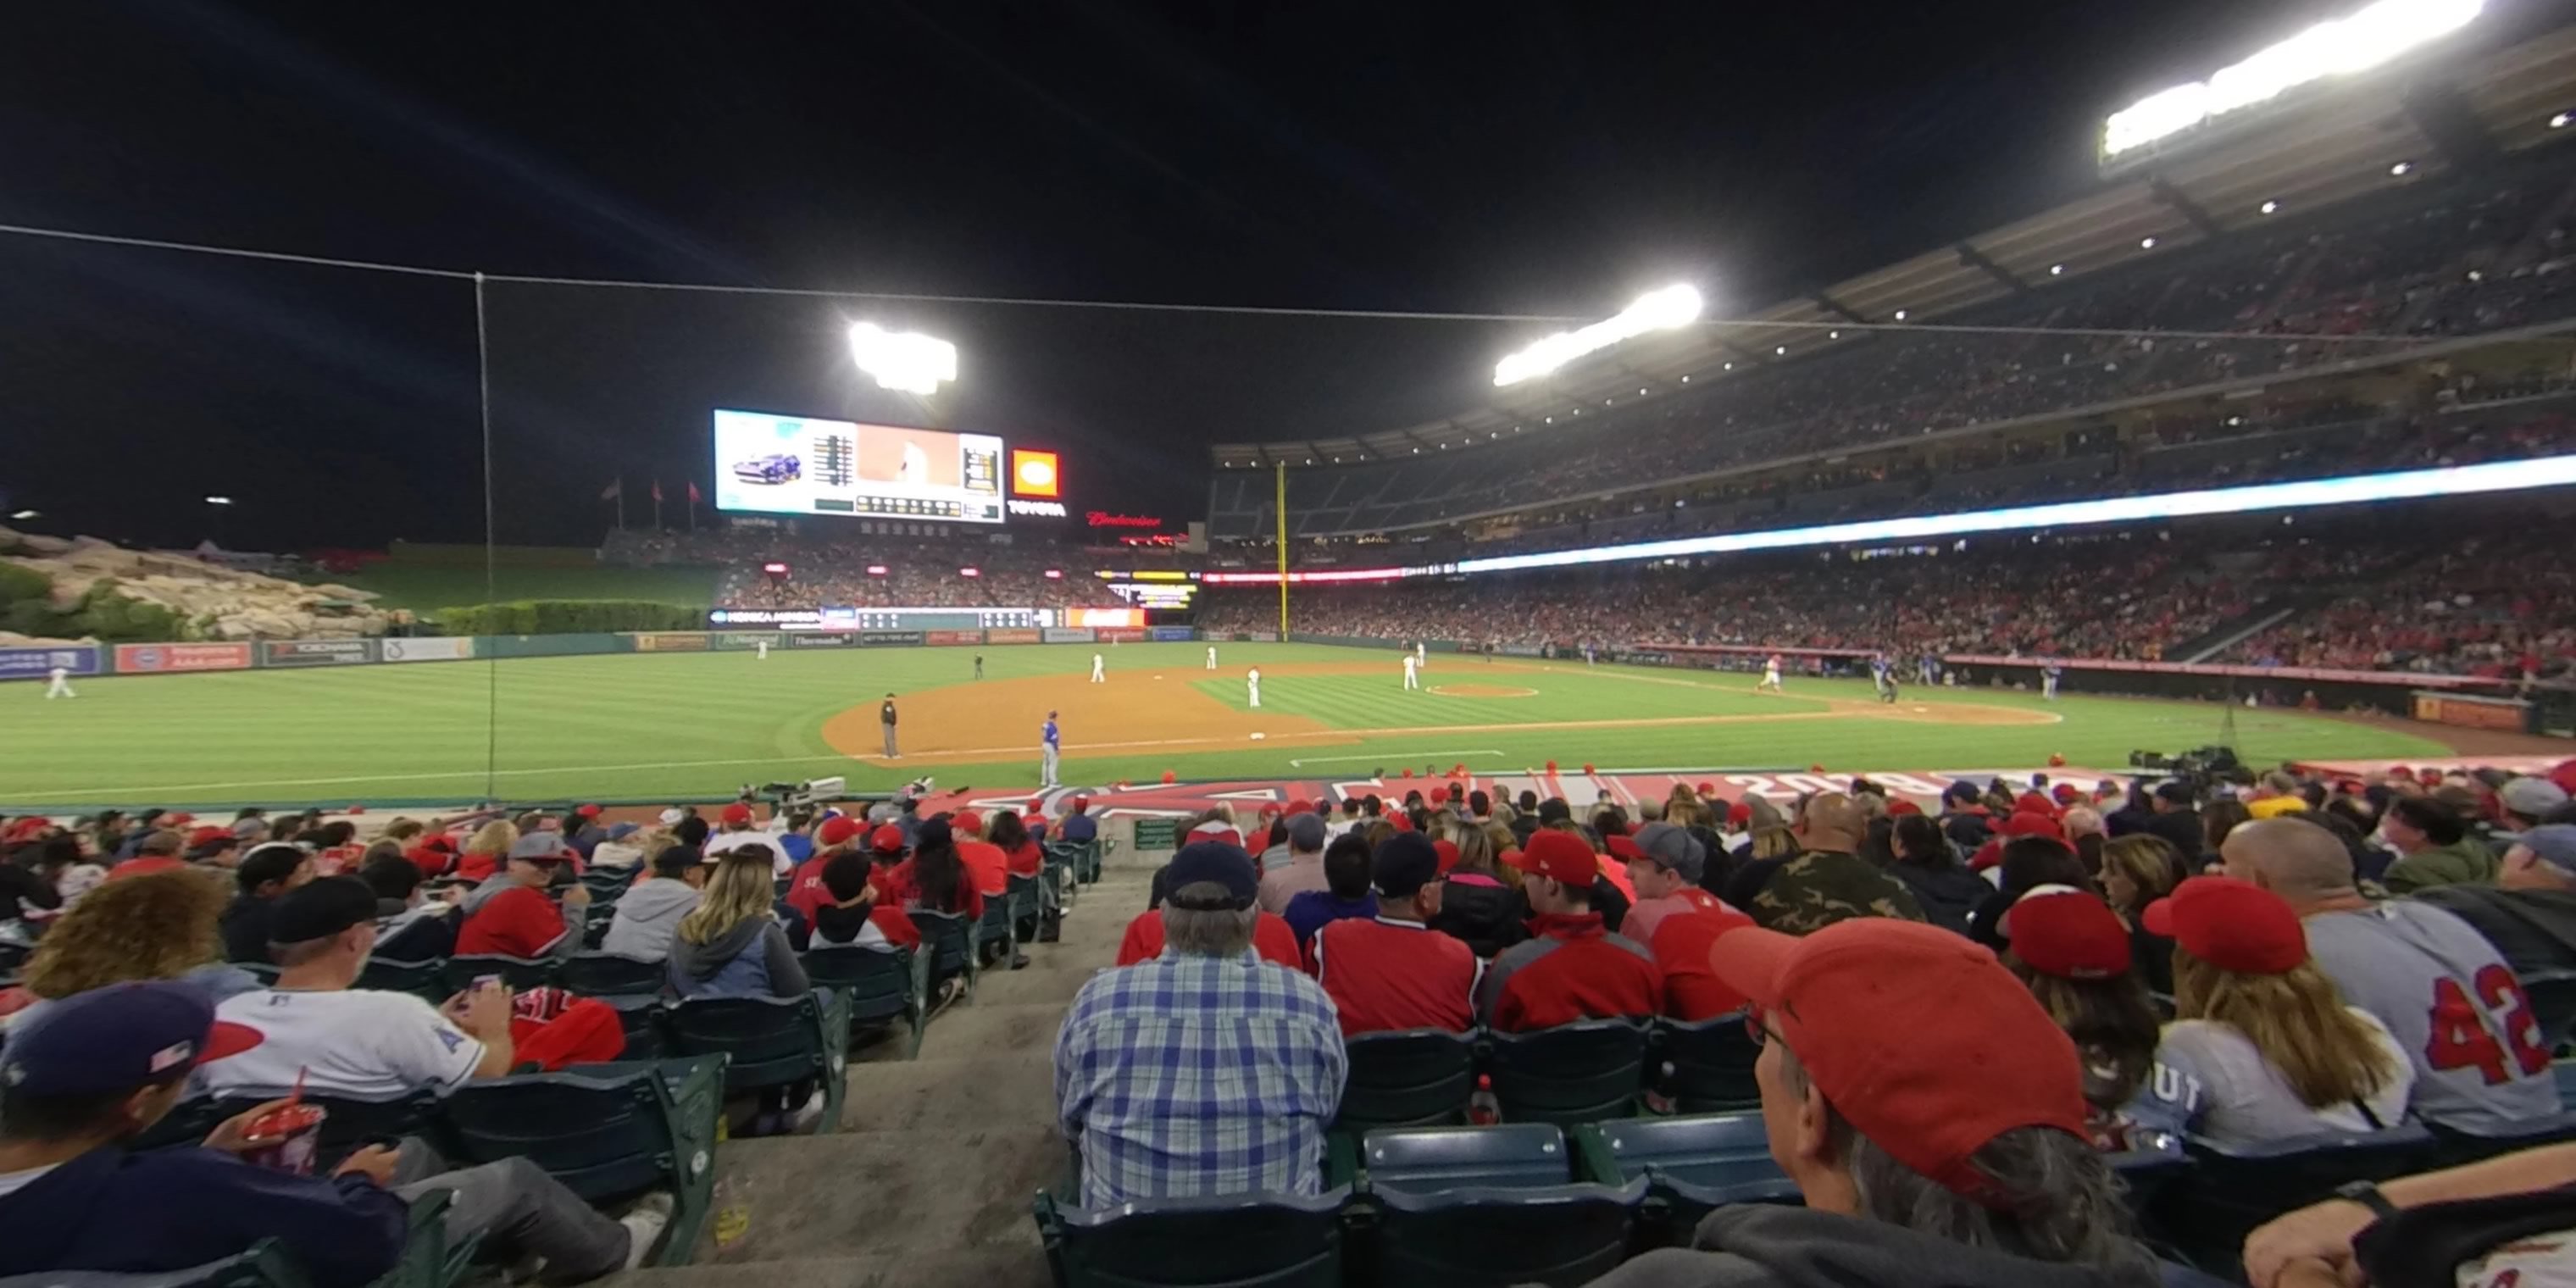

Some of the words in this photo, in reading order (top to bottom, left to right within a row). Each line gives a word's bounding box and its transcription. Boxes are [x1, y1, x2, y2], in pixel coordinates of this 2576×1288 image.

[1007, 500, 1067, 518] TOYOTA
[1085, 510, 1162, 527] Budweiser
[727, 610, 773, 624] KONICA
[297, 642, 364, 653] YOKOHAMA
[2423, 963, 2552, 1086] 42
